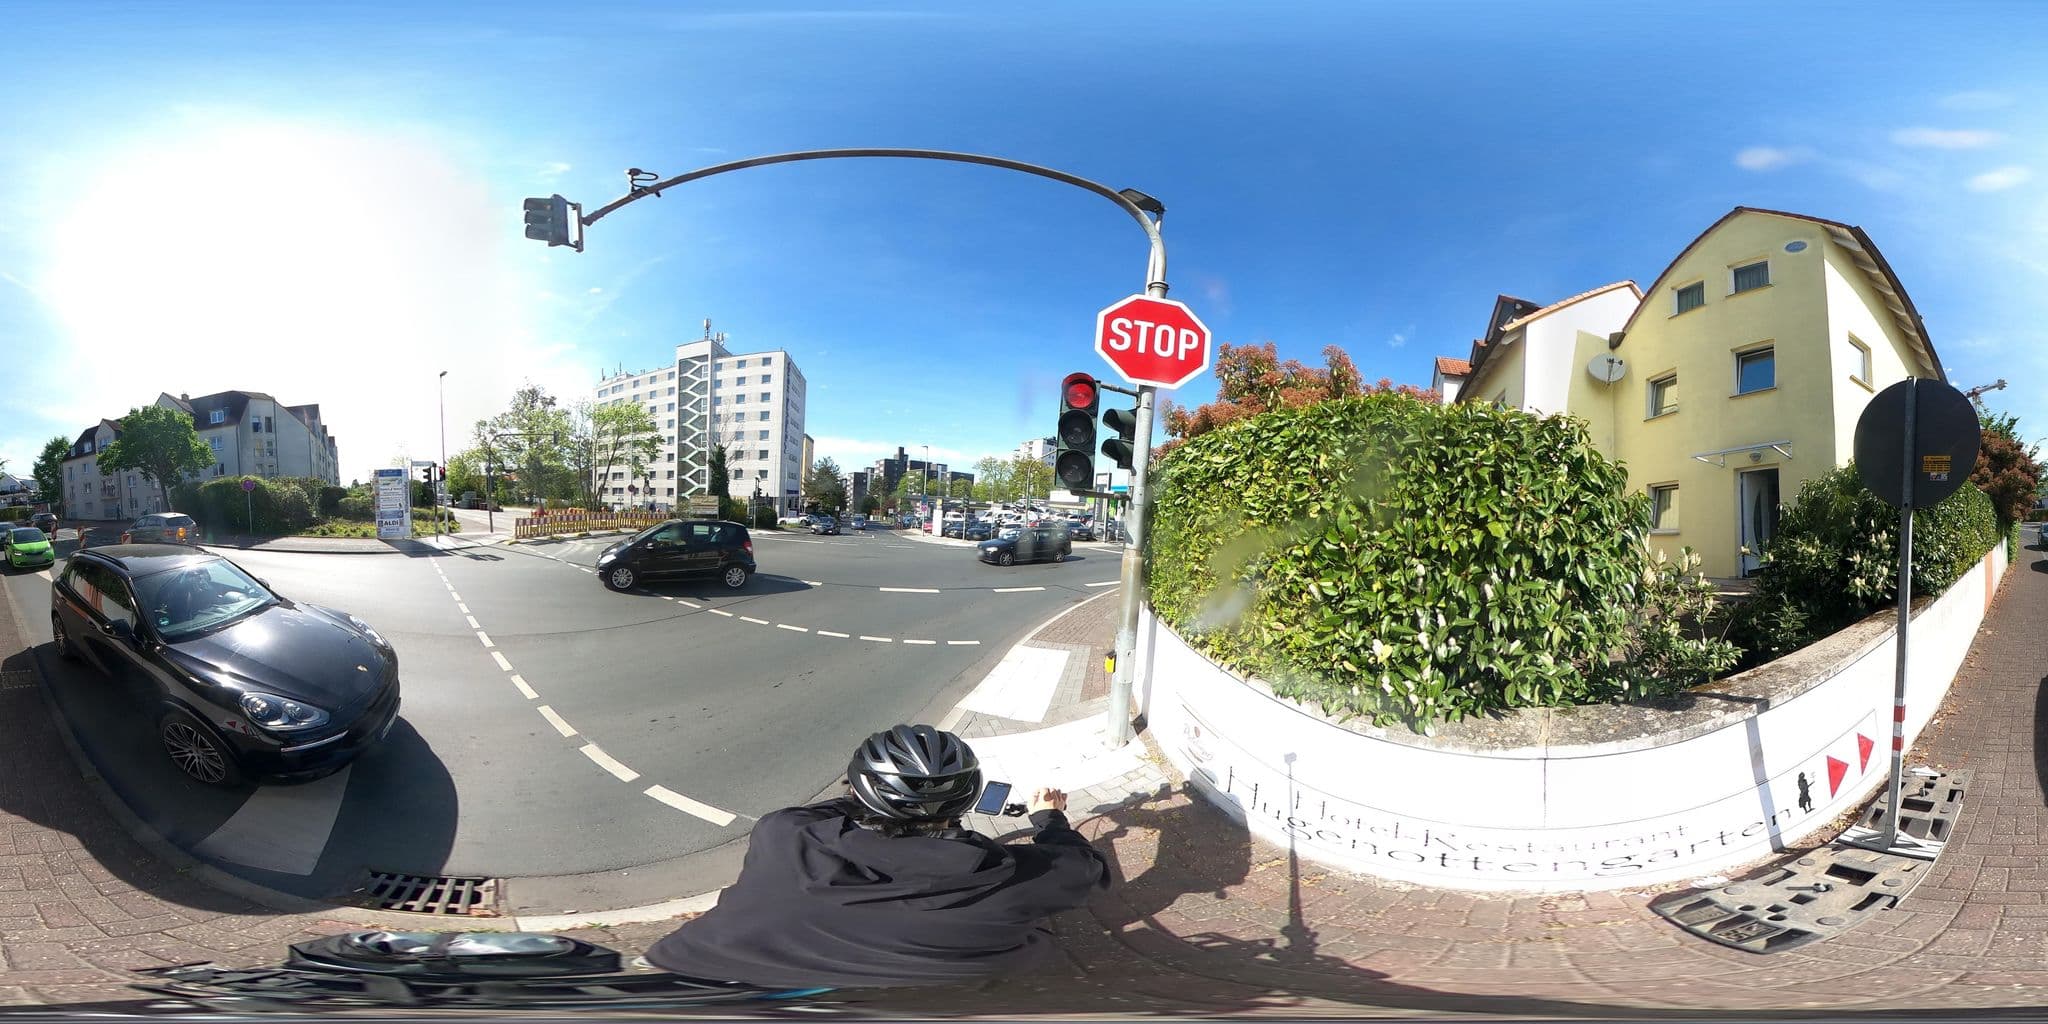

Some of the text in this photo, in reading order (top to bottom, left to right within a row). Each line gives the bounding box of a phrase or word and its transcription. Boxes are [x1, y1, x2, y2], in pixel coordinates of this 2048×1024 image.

[1109, 317, 1199, 361] STOP
[383, 519, 399, 527] ALDI
[1227, 765, 1792, 877] Hugenottengarten
[1295, 790, 1690, 853] Hotel-Restaurant
